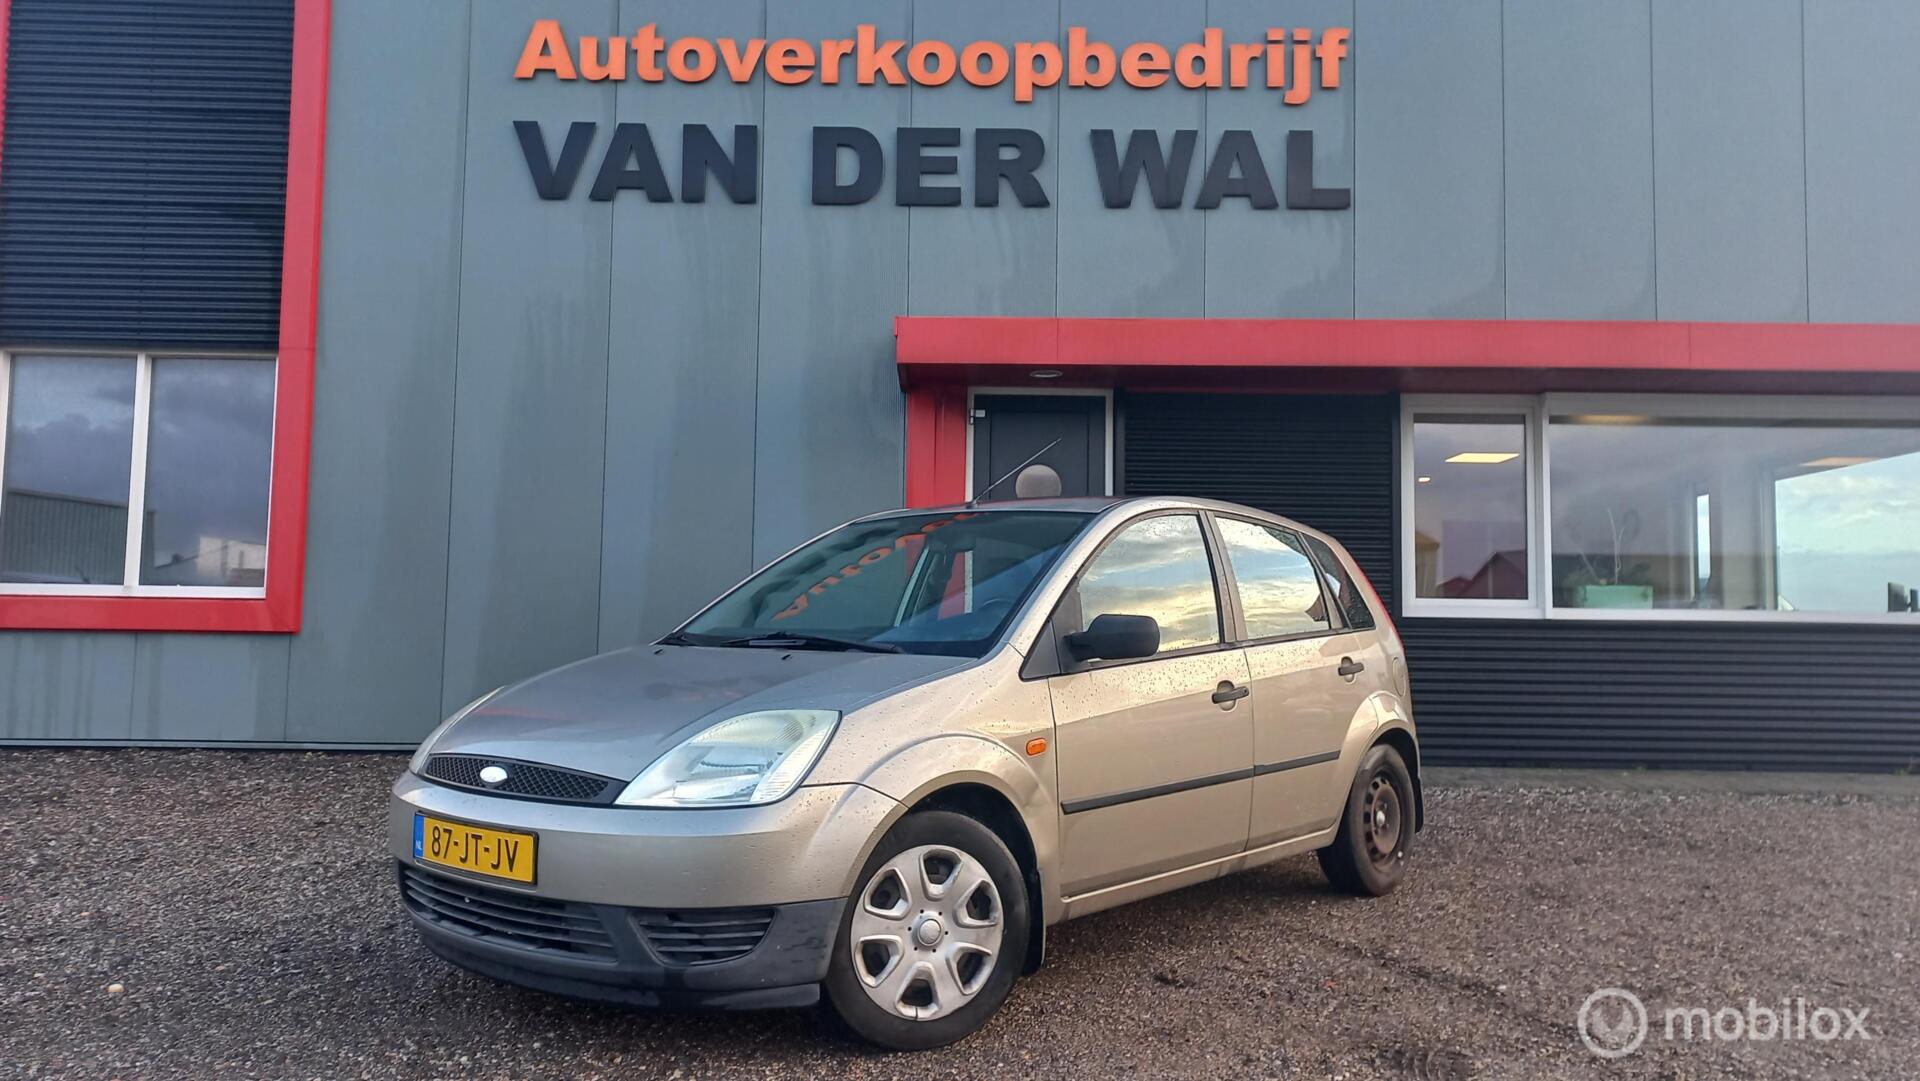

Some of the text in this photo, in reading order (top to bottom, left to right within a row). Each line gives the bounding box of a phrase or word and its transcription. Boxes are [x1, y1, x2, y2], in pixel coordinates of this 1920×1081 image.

[514, 19, 1350, 105] Autoverkoopbedrijf
[514, 120, 1352, 210] VAN DER WAL
[431, 825, 519, 873] 87-JT-JV
